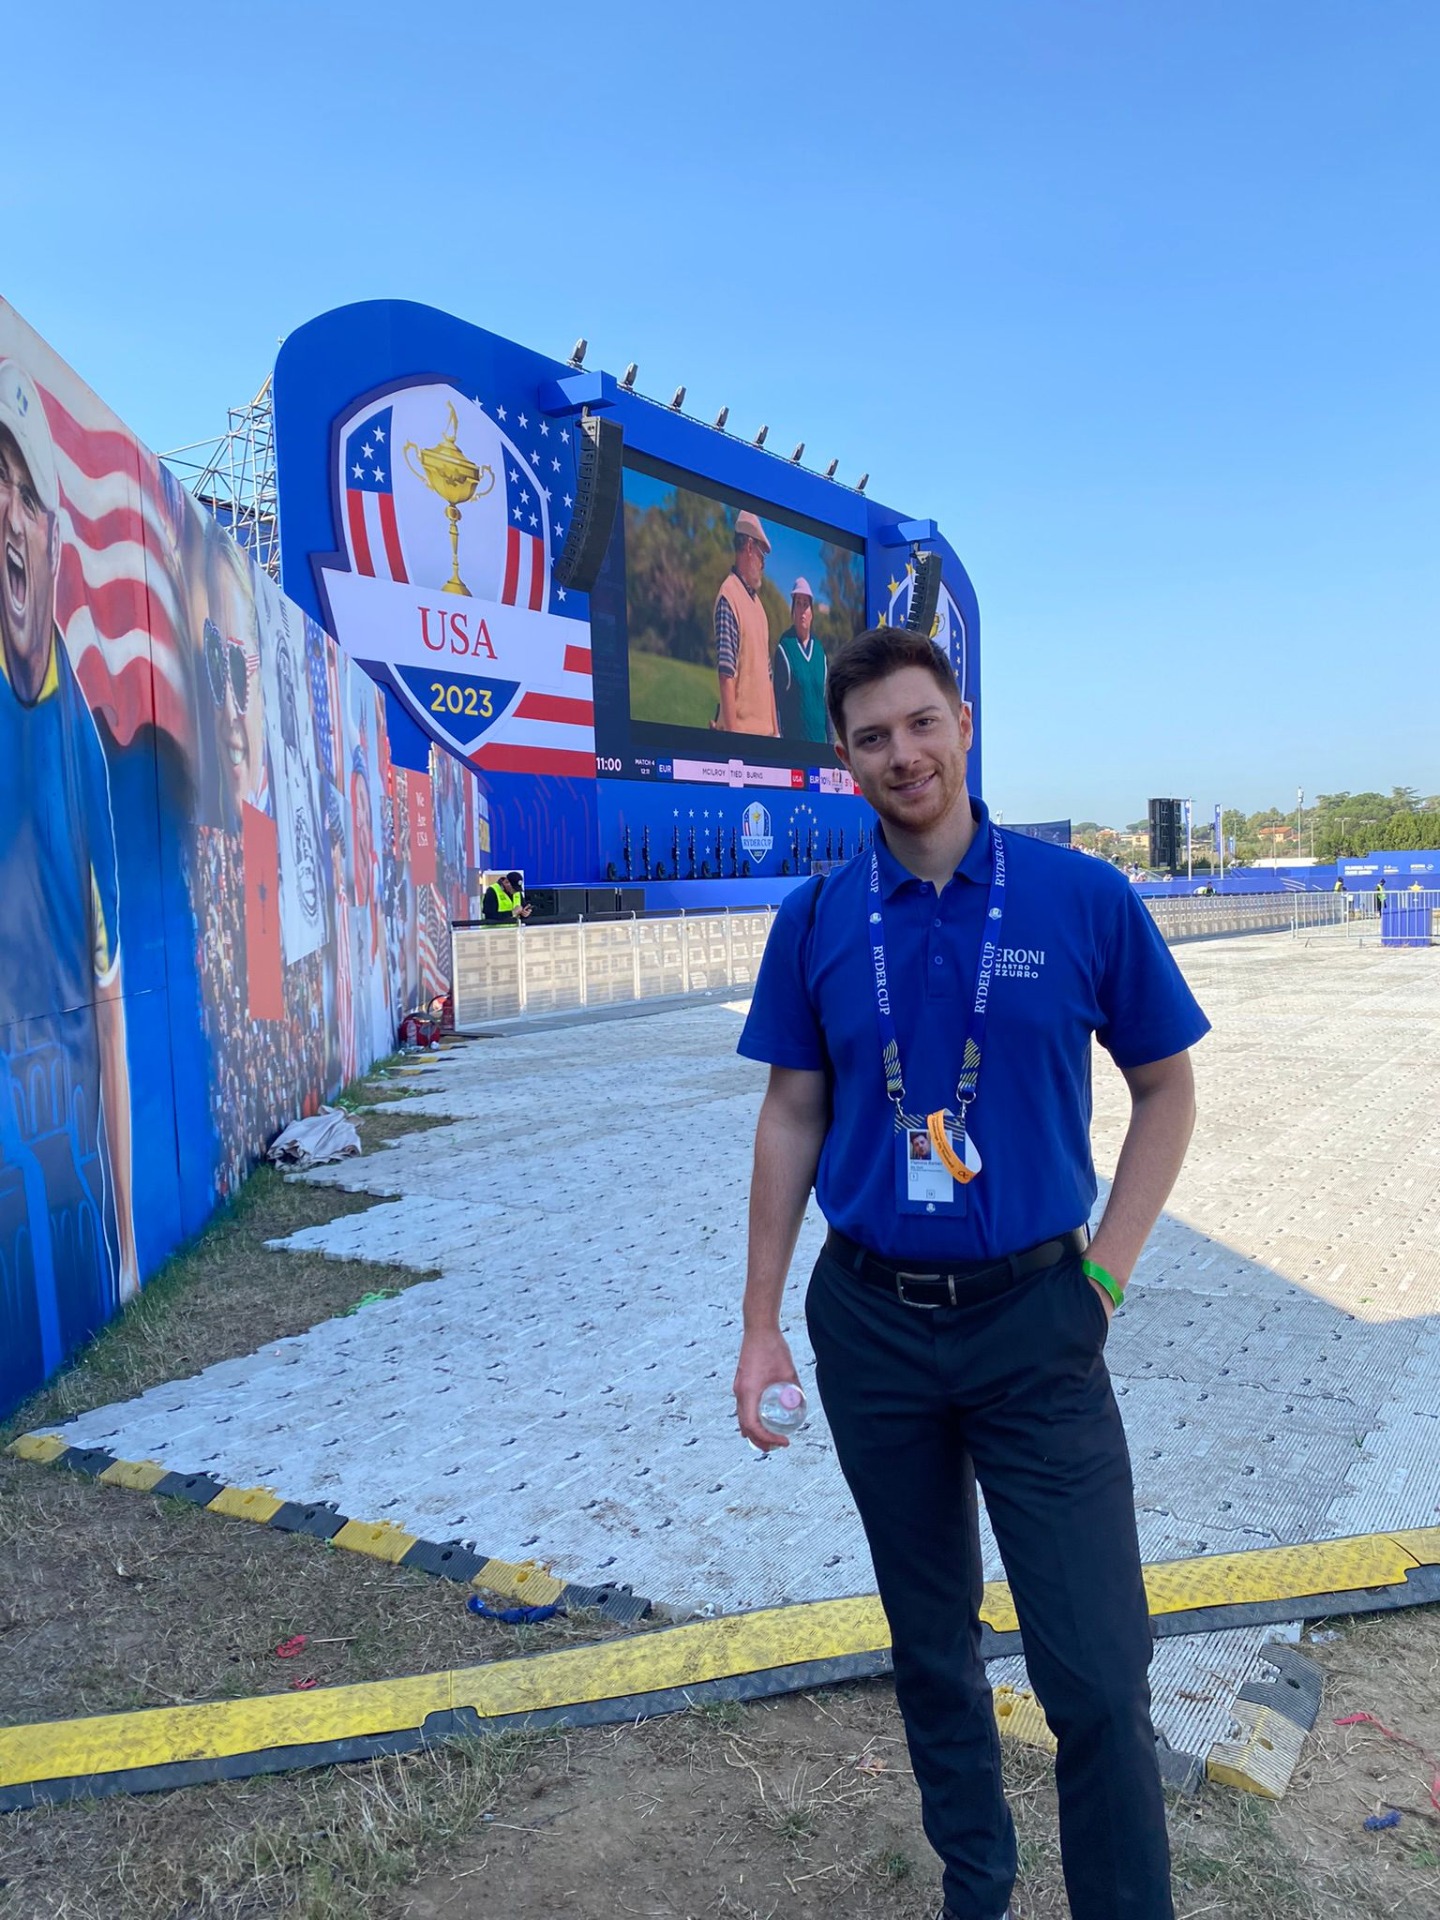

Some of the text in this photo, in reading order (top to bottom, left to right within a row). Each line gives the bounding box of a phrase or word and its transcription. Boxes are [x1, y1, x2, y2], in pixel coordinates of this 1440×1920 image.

[418, 606, 498, 660] USA
[430, 683, 493, 717] 2023
[596, 757, 622, 771] 11:00
[658, 764, 672, 773] EUR
[702, 768, 763, 779] MCILROY TIED BURNS
[792, 775, 803, 783] USA
[809, 775, 819, 784] EUR
[415, 791, 425, 807] We
[417, 811, 427, 827] Are
[416, 831, 429, 847] USA
[743, 838, 772, 847] RYDER CUP
[992, 828, 1005, 887] RYDER CUP
[870, 870, 879, 893] CUP
[995, 948, 1045, 965] ERONI
[994, 969, 1039, 979] ZZURRO
[995, 963, 1030, 971] NASTRO
[873, 945, 891, 1015] RYDER CUP
[974, 941, 996, 1014] RYDER CUP
